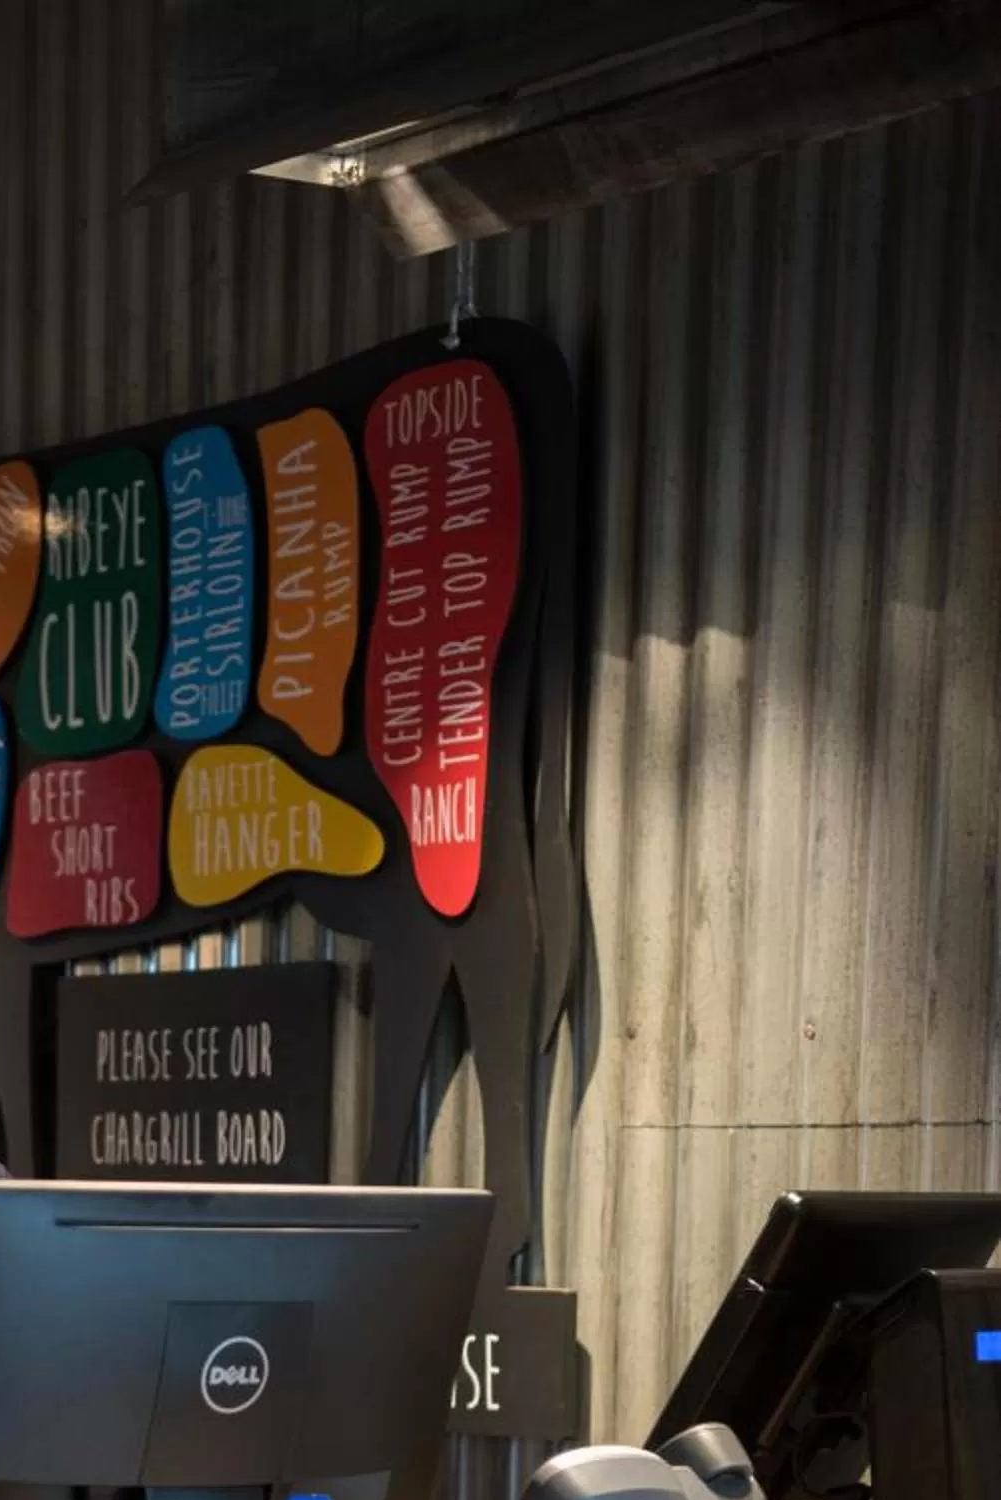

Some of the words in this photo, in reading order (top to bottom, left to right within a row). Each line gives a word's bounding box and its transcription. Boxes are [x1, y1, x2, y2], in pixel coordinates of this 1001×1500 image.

[383, 374, 484, 448] TOPSIDE
[386, 462, 430, 549] RUMP
[441, 437, 493, 532] RUMP
[47, 480, 146, 581] RIBEYE
[169, 444, 204, 728] PORTERHOUSE
[205, 530, 244, 677] SIRLOIN
[271, 439, 318, 700] PICANHA
[320, 521, 352, 629] RUMP
[387, 567, 427, 628] CUT
[442, 552, 489, 618] TOP
[39, 591, 140, 730] CLUB
[381, 646, 425, 766] CENTRE
[436, 634, 488, 772] TENDER
[28, 768, 87, 825] BEEF
[410, 777, 477, 846] RANCH
[51, 826, 117, 877] SHORT
[194, 800, 324, 877] HANGER
[85, 877, 140, 925] RIBS
[97, 1028, 173, 1082] PLEASE
[183, 1026, 219, 1080] SEE
[230, 1021, 273, 1078] OUR
[91, 1111, 205, 1167] CHARGRILL
[216, 1109, 286, 1166] BOARD
[209, 1363, 261, 1387] DELL
